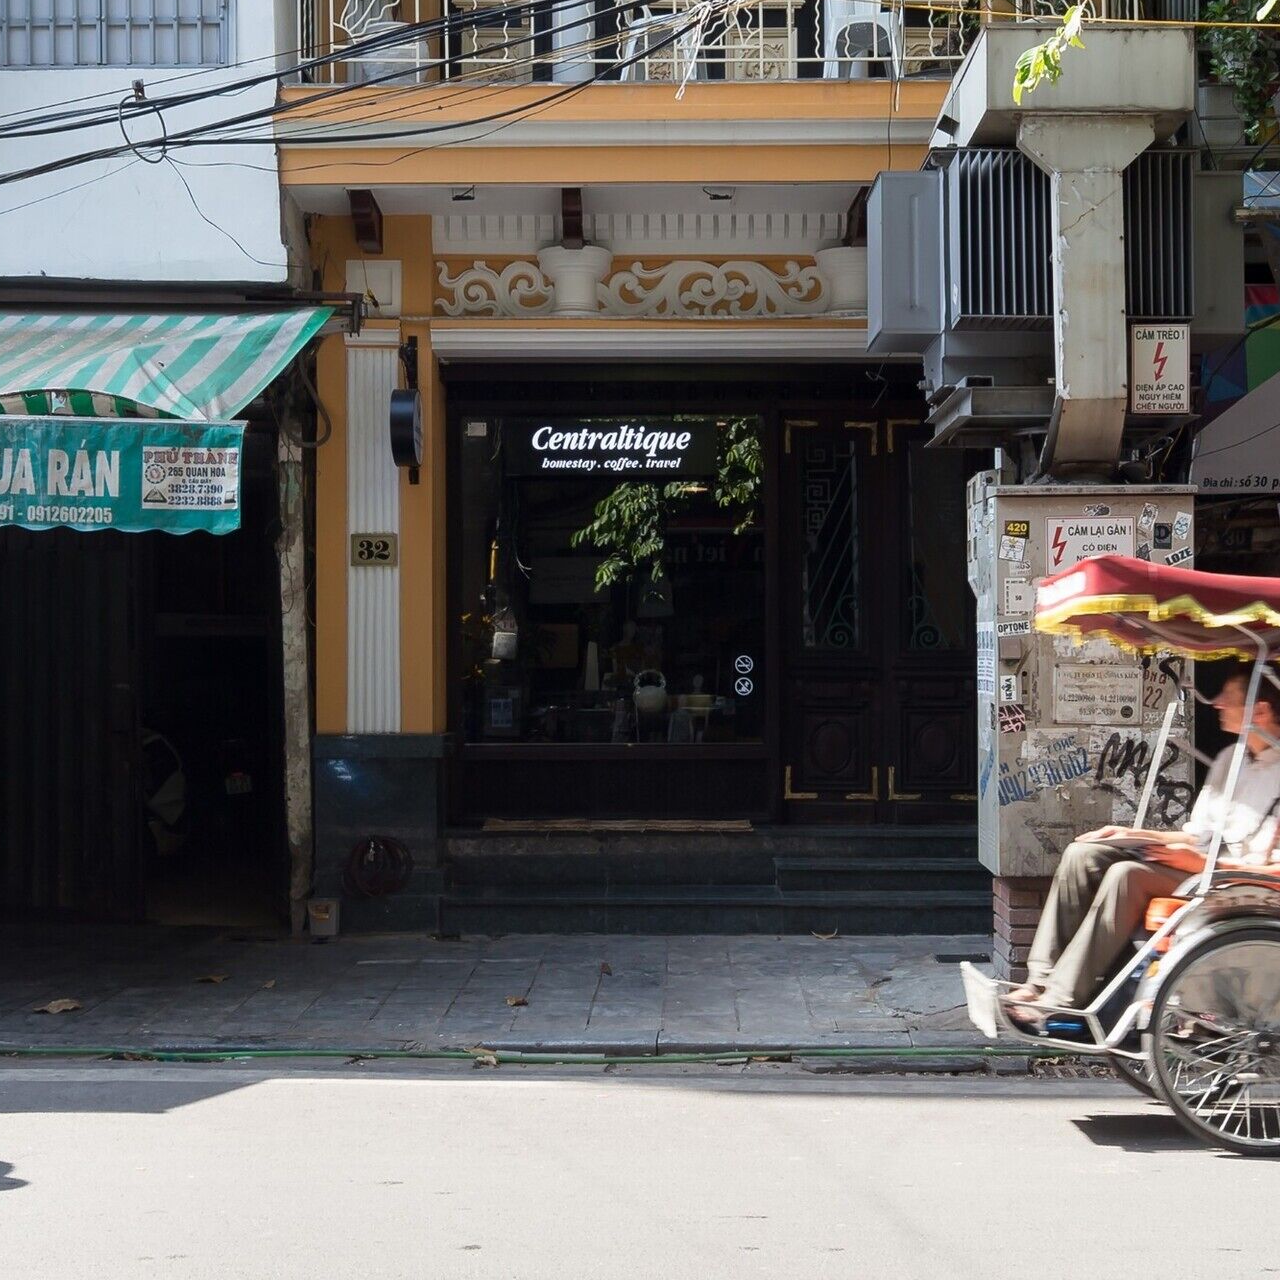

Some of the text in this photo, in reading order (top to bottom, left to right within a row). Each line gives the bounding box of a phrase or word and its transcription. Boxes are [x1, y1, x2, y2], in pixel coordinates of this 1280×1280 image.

[1136, 328, 1180, 341] CẤM TRÈO
[1167, 383, 1185, 391] CAO
[1139, 393, 1161, 401] NGUY
[531, 424, 692, 457] Centraltique
[46, 436, 120, 498] RÁN
[645, 458, 682, 469] travel
[167, 466, 226, 478] 265 QUAN HOA
[1253, 476, 1268, 487] 30
[27, 504, 113, 524] 0912602205
[1006, 523, 1028, 532] 420
[1067, 525, 1089, 537] CẤM
[1090, 525, 1105, 538] LẠI
[358, 539, 391, 561] 32
[1082, 542, 1118, 553] CÓ ĐIỆN
[997, 621, 1030, 633] OPTONE
